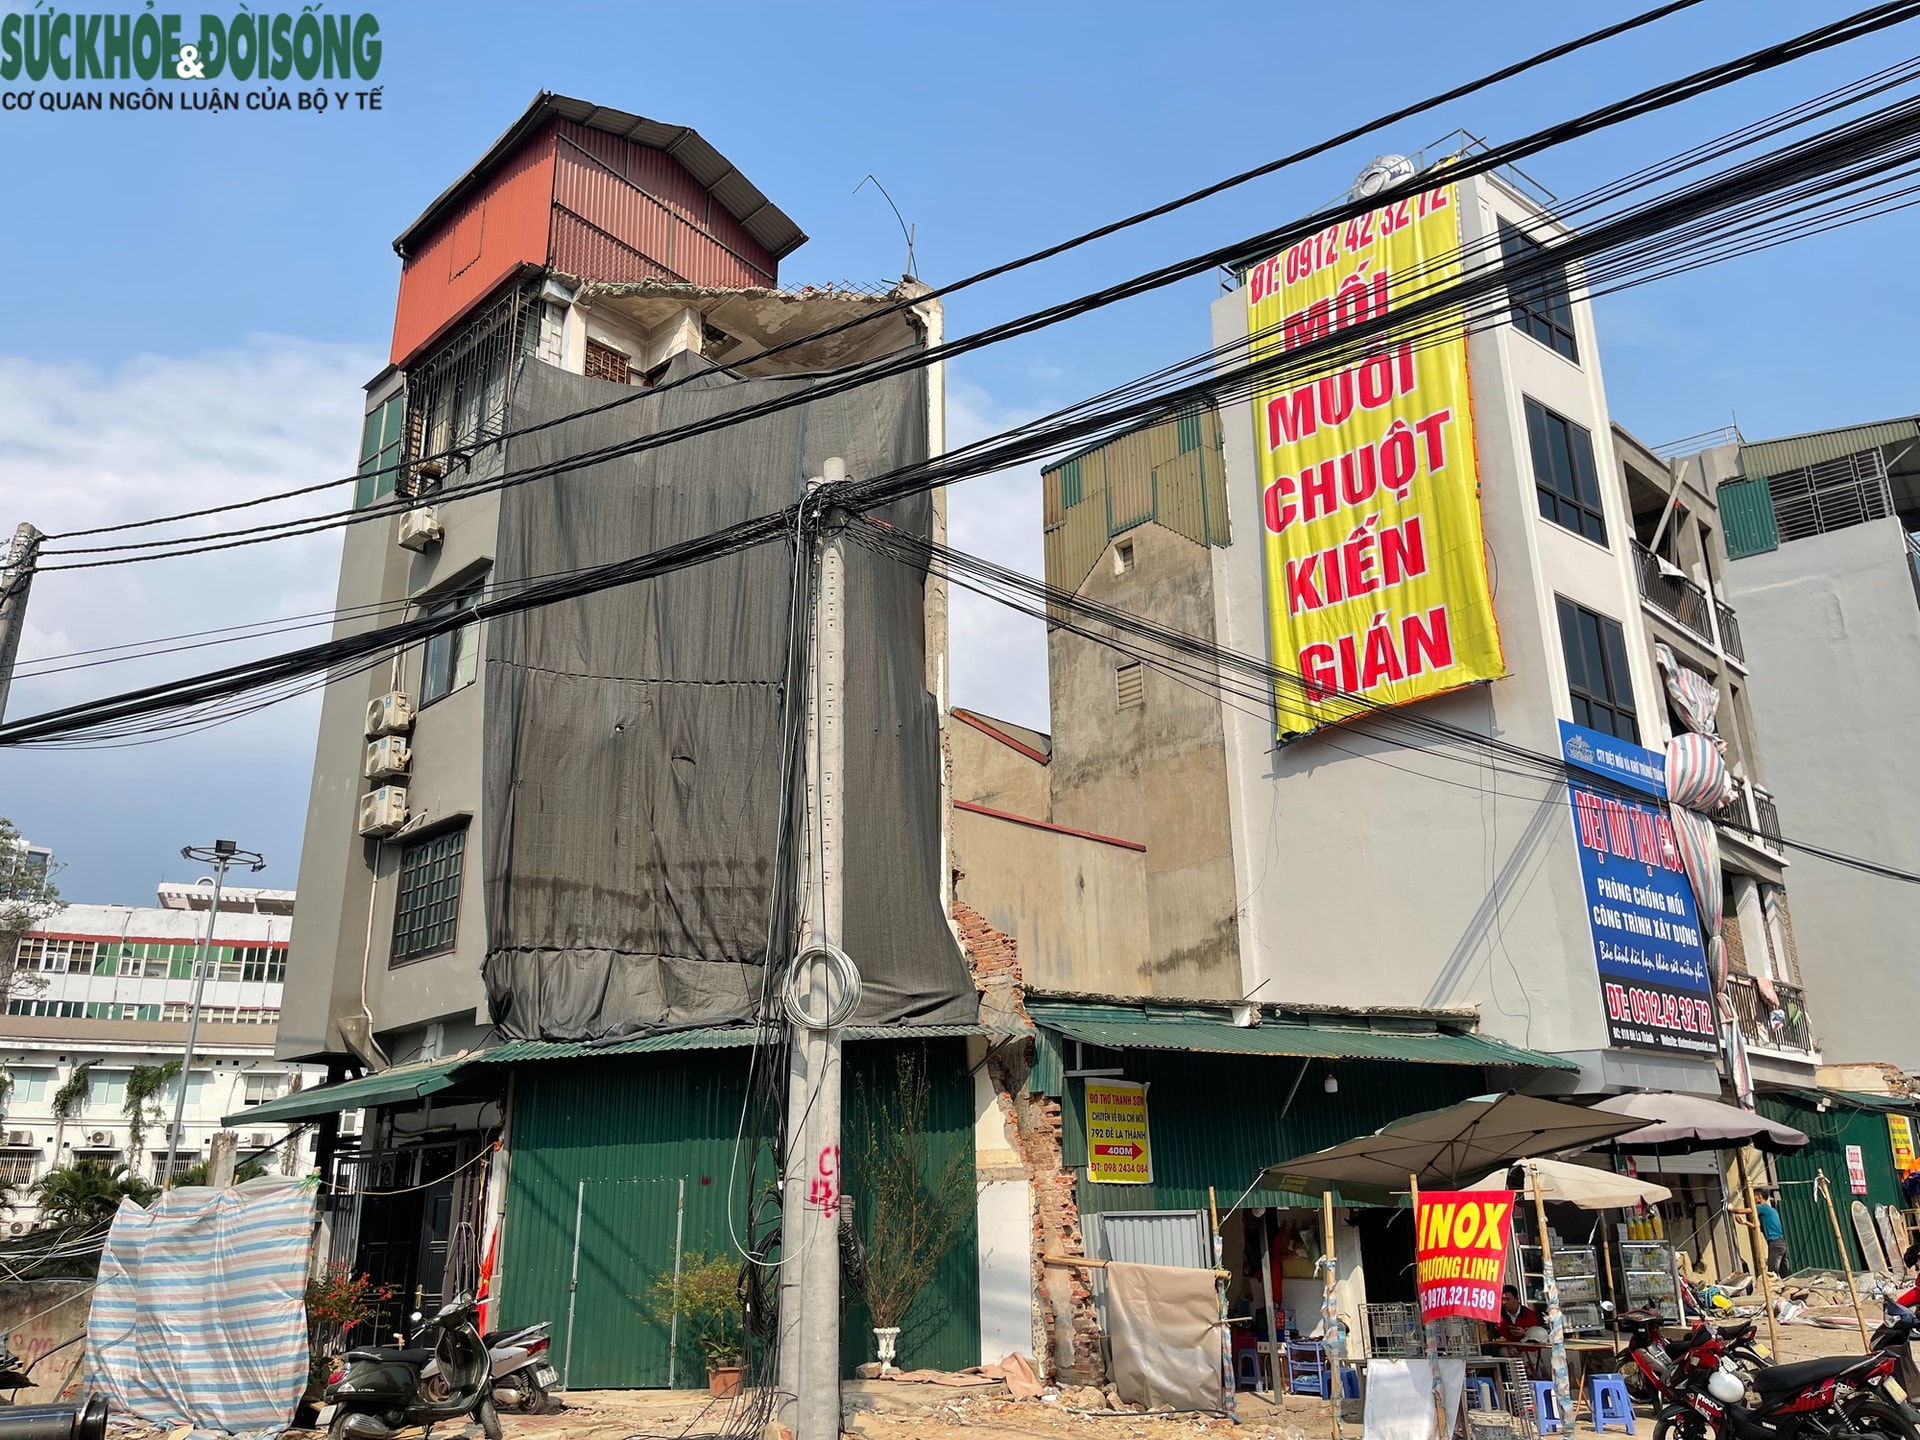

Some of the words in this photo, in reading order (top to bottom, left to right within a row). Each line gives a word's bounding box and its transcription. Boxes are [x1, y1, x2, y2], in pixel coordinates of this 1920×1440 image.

[1250, 260, 1281, 305] ĐT:
[1285, 222, 1339, 286] 0912
[1283, 260, 1389, 351] MỐI
[1264, 410, 1450, 533] CHUỘT
[1286, 514, 1427, 616] KIẾN
[1299, 606, 1453, 703] GIÁN
[1575, 785, 1609, 864] DIỆT
[1604, 793, 1636, 860] MỐI
[1629, 800, 1661, 877] TẬN
[1597, 877, 1631, 902] PHÒNG
[1633, 885, 1666, 911] CHỐNG
[1666, 892, 1685, 916] MỐI
[1593, 905, 1621, 930] CÔNG
[1622, 911, 1652, 936] TRÌNH
[1654, 917, 1671, 941] XÂY
[1673, 924, 1698, 948] DỰNG
[1599, 940, 1613, 960] Bảo
[1613, 943, 1630, 963] hành
[1605, 983, 1631, 1022] ĐT:
[1091, 1128, 1103, 1138] 792
[1116, 1129, 1123, 1139] LA
[1108, 1146, 1133, 1155] 400M
[1418, 1202, 1508, 1251] INOX
[1418, 1255, 1462, 1284] PHƯƠNG
[1462, 1257, 1500, 1282] LINH
[1427, 1286, 1496, 1311] 0978.321.589
